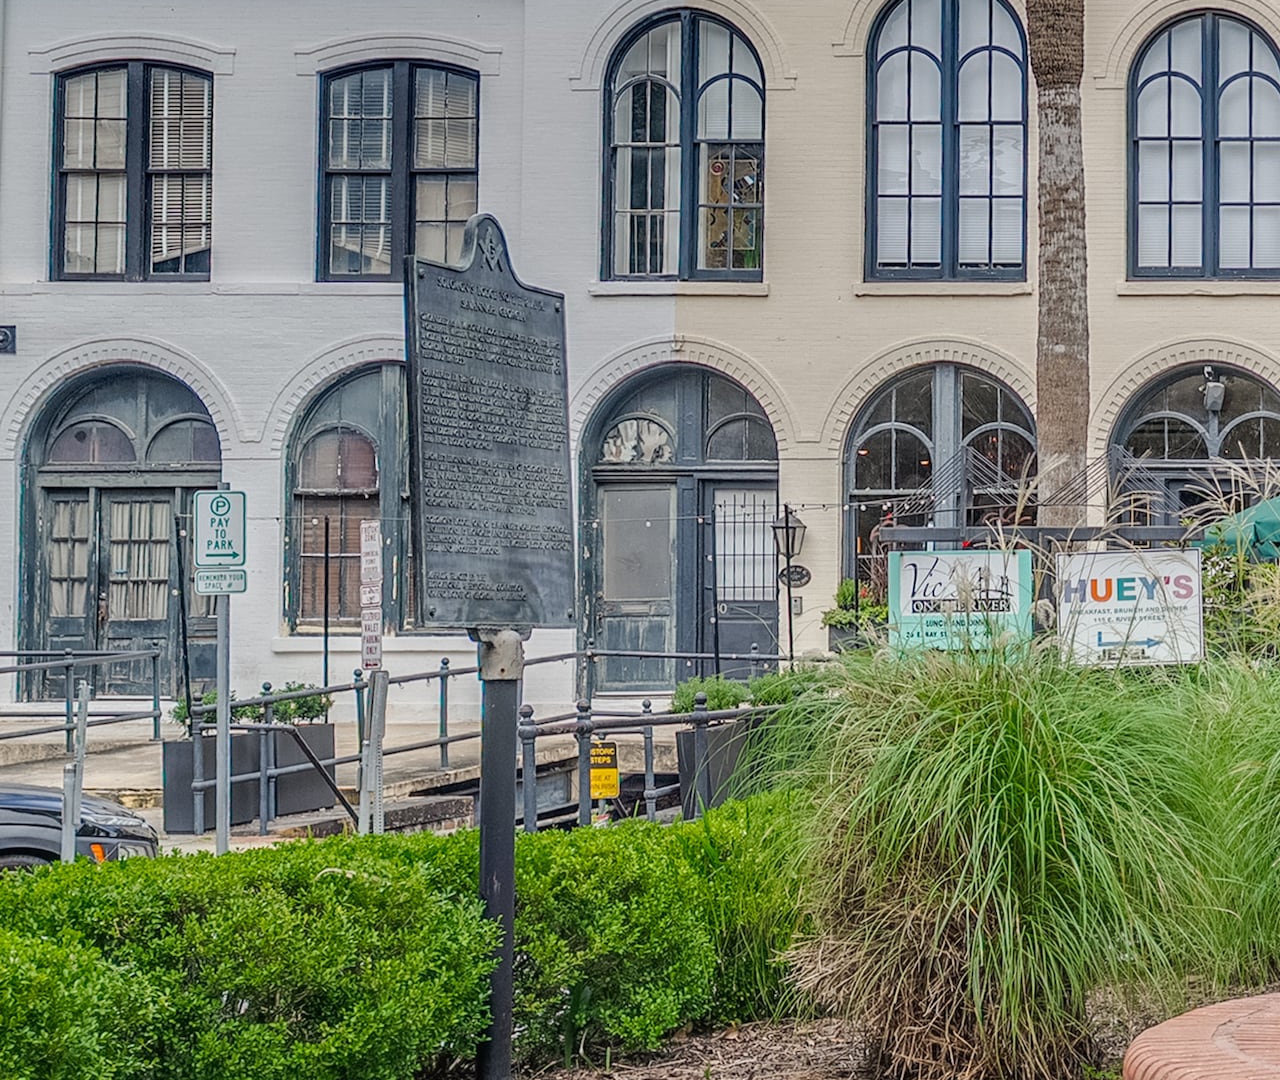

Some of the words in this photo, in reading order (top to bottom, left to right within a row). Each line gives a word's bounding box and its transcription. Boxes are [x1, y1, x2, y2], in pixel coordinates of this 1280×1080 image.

[210, 518, 230, 527] PAY
[215, 529, 226, 539] TO
[207, 540, 234, 550] PARK
[1064, 575, 1194, 603] HUEY'S
[590, 756, 611, 764] STEPS
